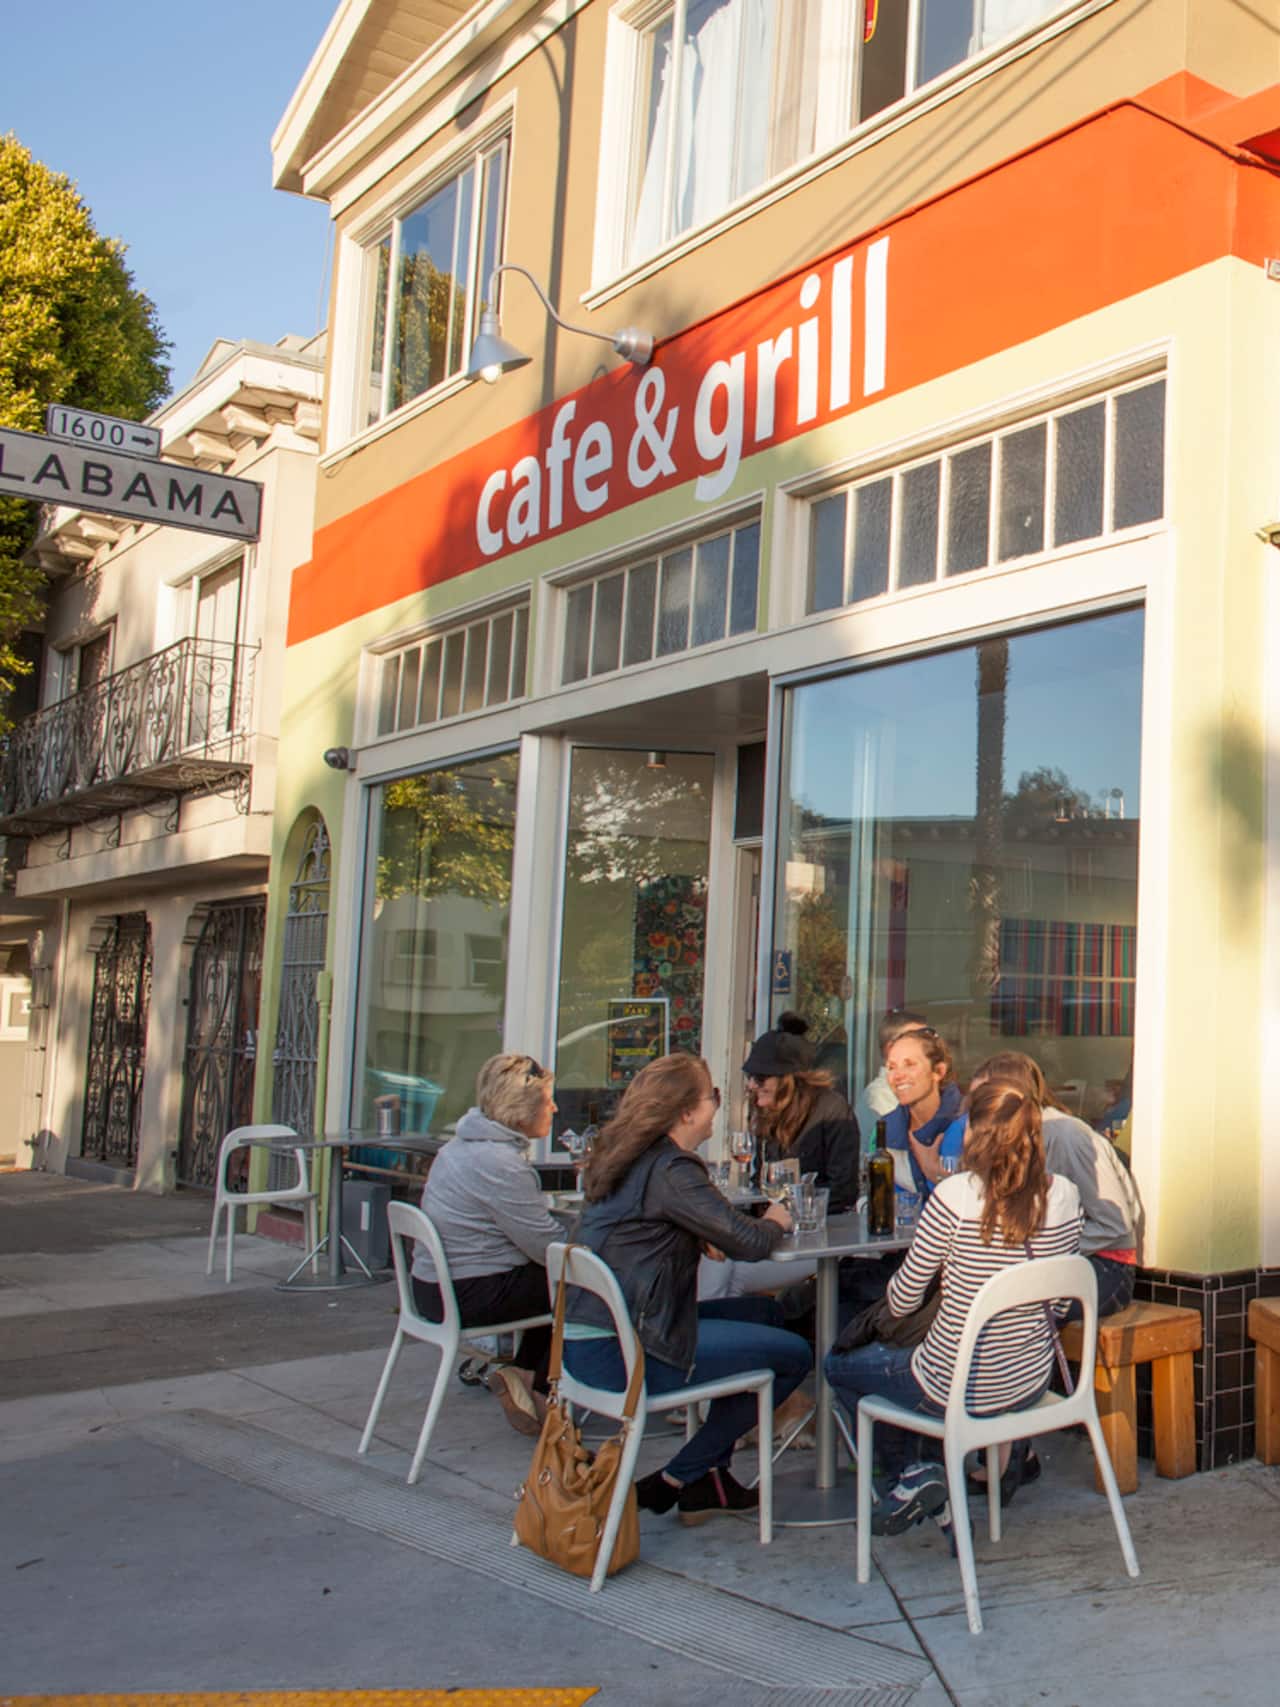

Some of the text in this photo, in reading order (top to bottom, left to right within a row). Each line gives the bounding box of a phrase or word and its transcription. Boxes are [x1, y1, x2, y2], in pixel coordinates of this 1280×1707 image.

[60, 412, 126, 446] 1600
[475, 235, 890, 556] cafe & grill
